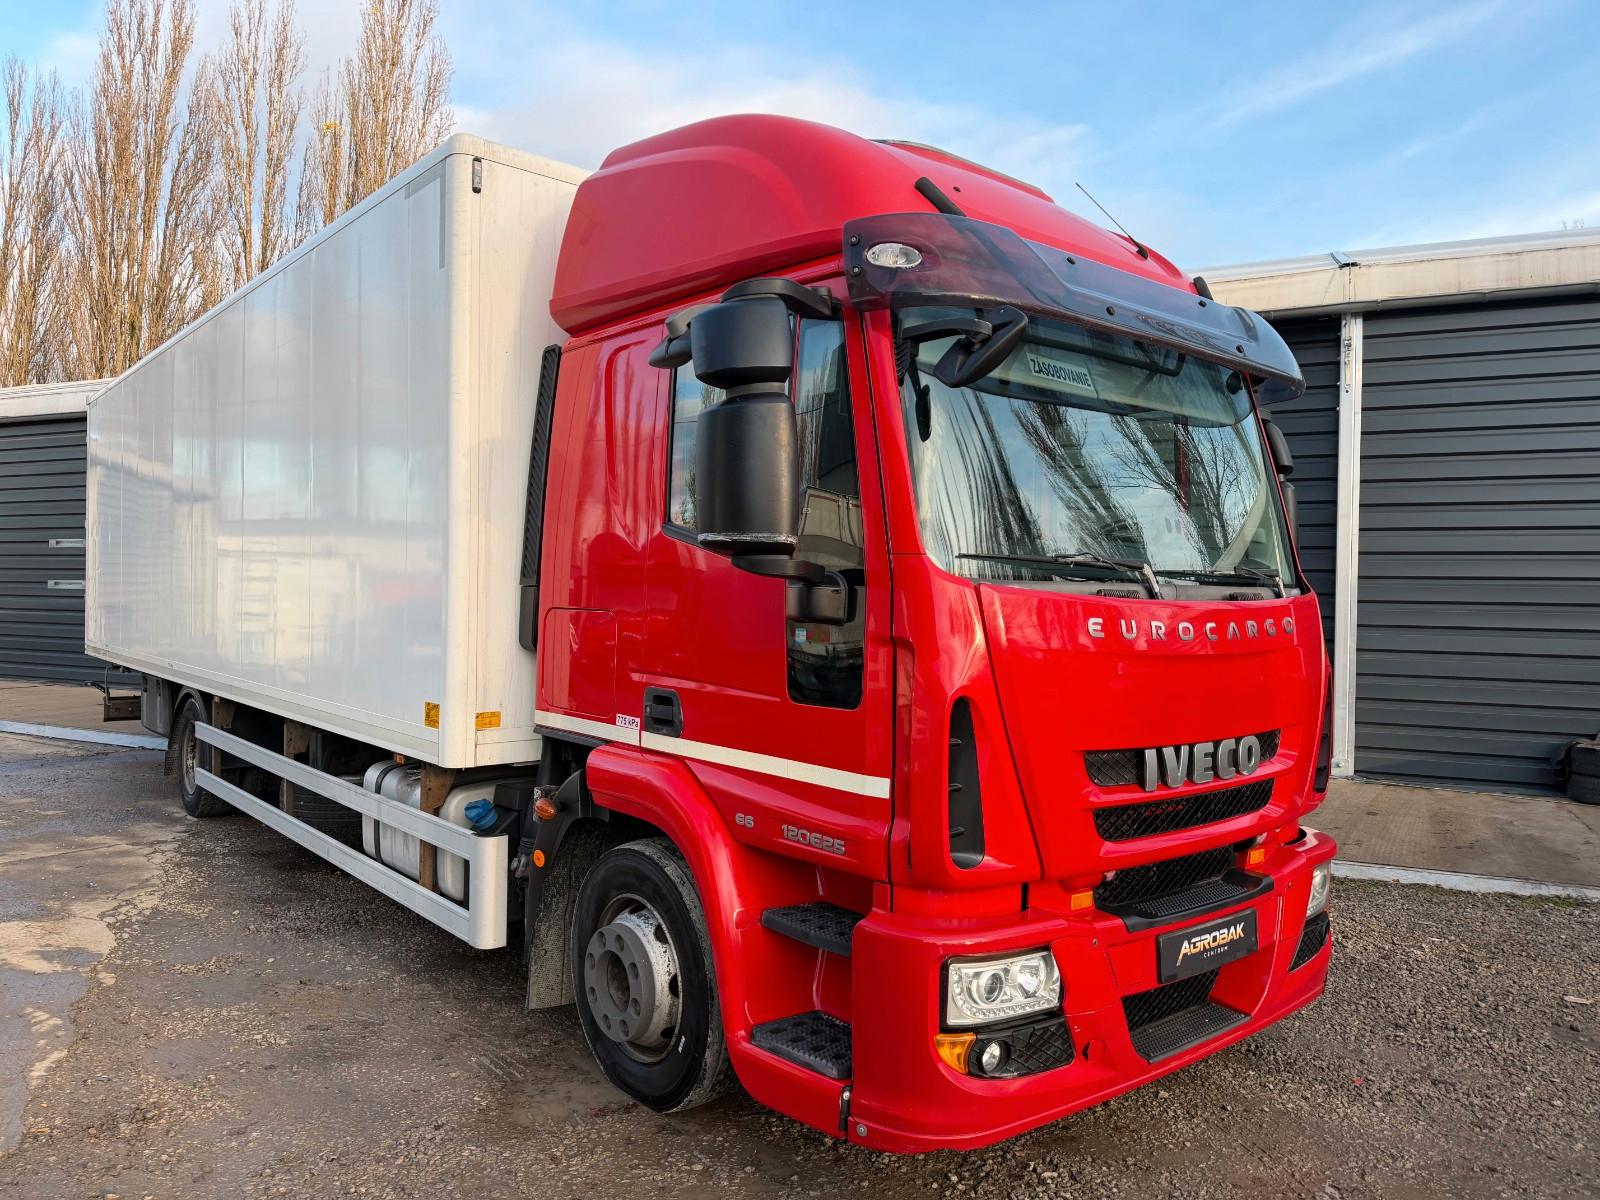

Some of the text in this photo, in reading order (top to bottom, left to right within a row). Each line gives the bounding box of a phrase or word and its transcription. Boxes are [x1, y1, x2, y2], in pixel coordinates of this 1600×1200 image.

[1087, 616, 1294, 641] EUROCARGO
[1143, 734, 1261, 792] IVECO
[1176, 922, 1245, 966] AGROBAK
